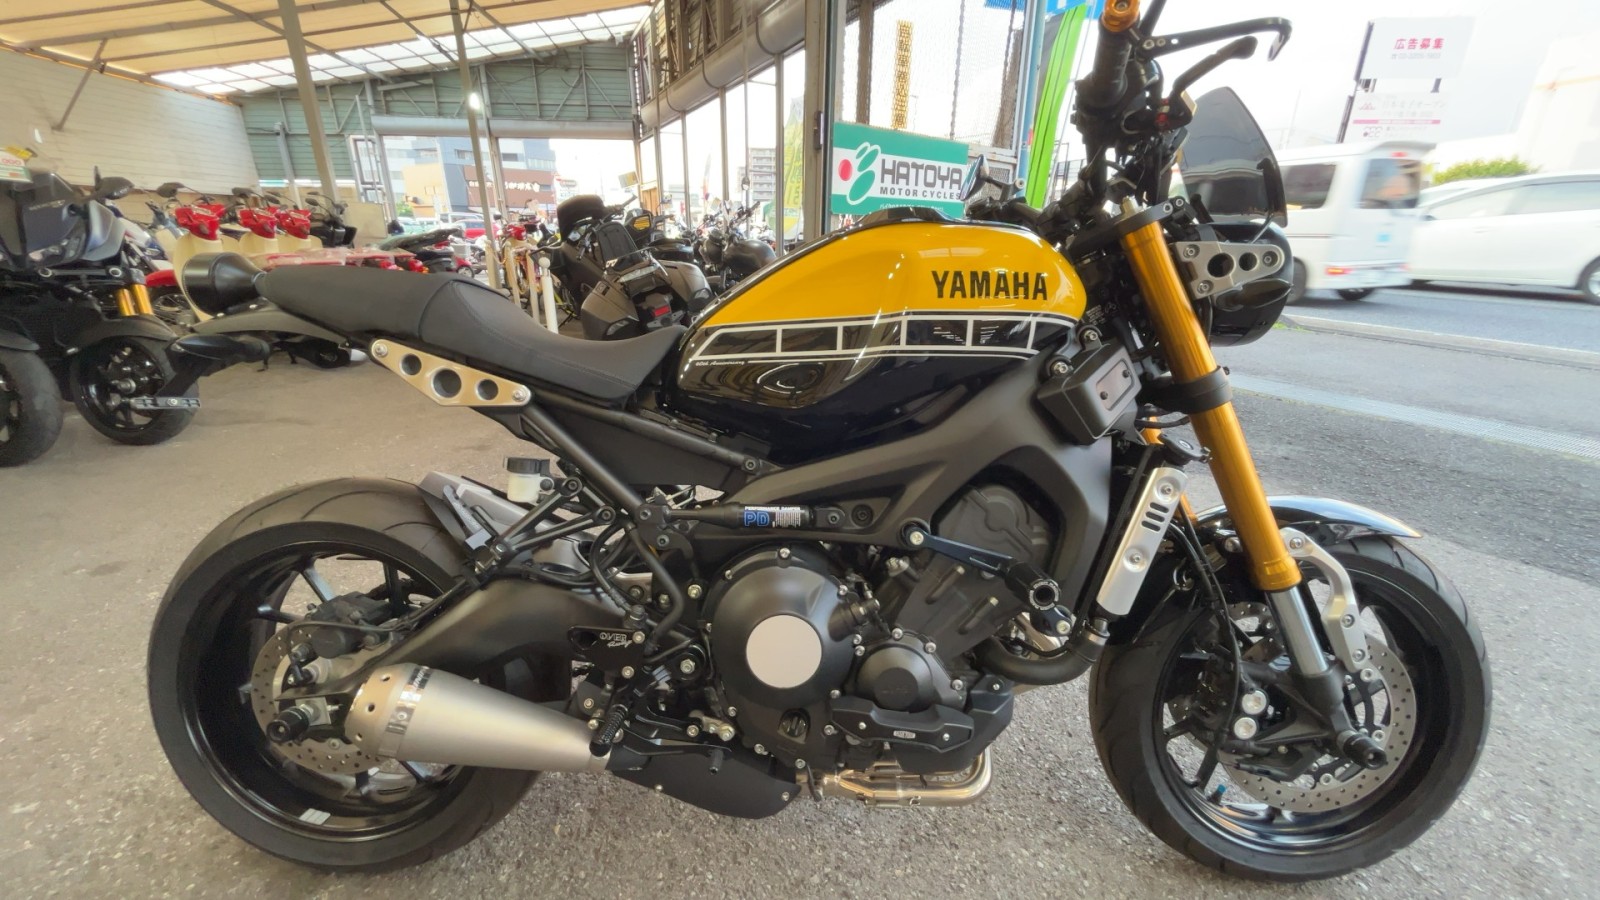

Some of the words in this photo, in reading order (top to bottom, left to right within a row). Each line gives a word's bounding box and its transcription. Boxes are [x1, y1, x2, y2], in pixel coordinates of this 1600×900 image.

[1394, 38, 1443, 49] 広告募集
[880, 158, 962, 190] HATOYA
[880, 186, 918, 197] MOTOR
[931, 270, 1048, 300] YAMAHA
[744, 511, 770, 527] PD
[600, 631, 627, 642] OVER
